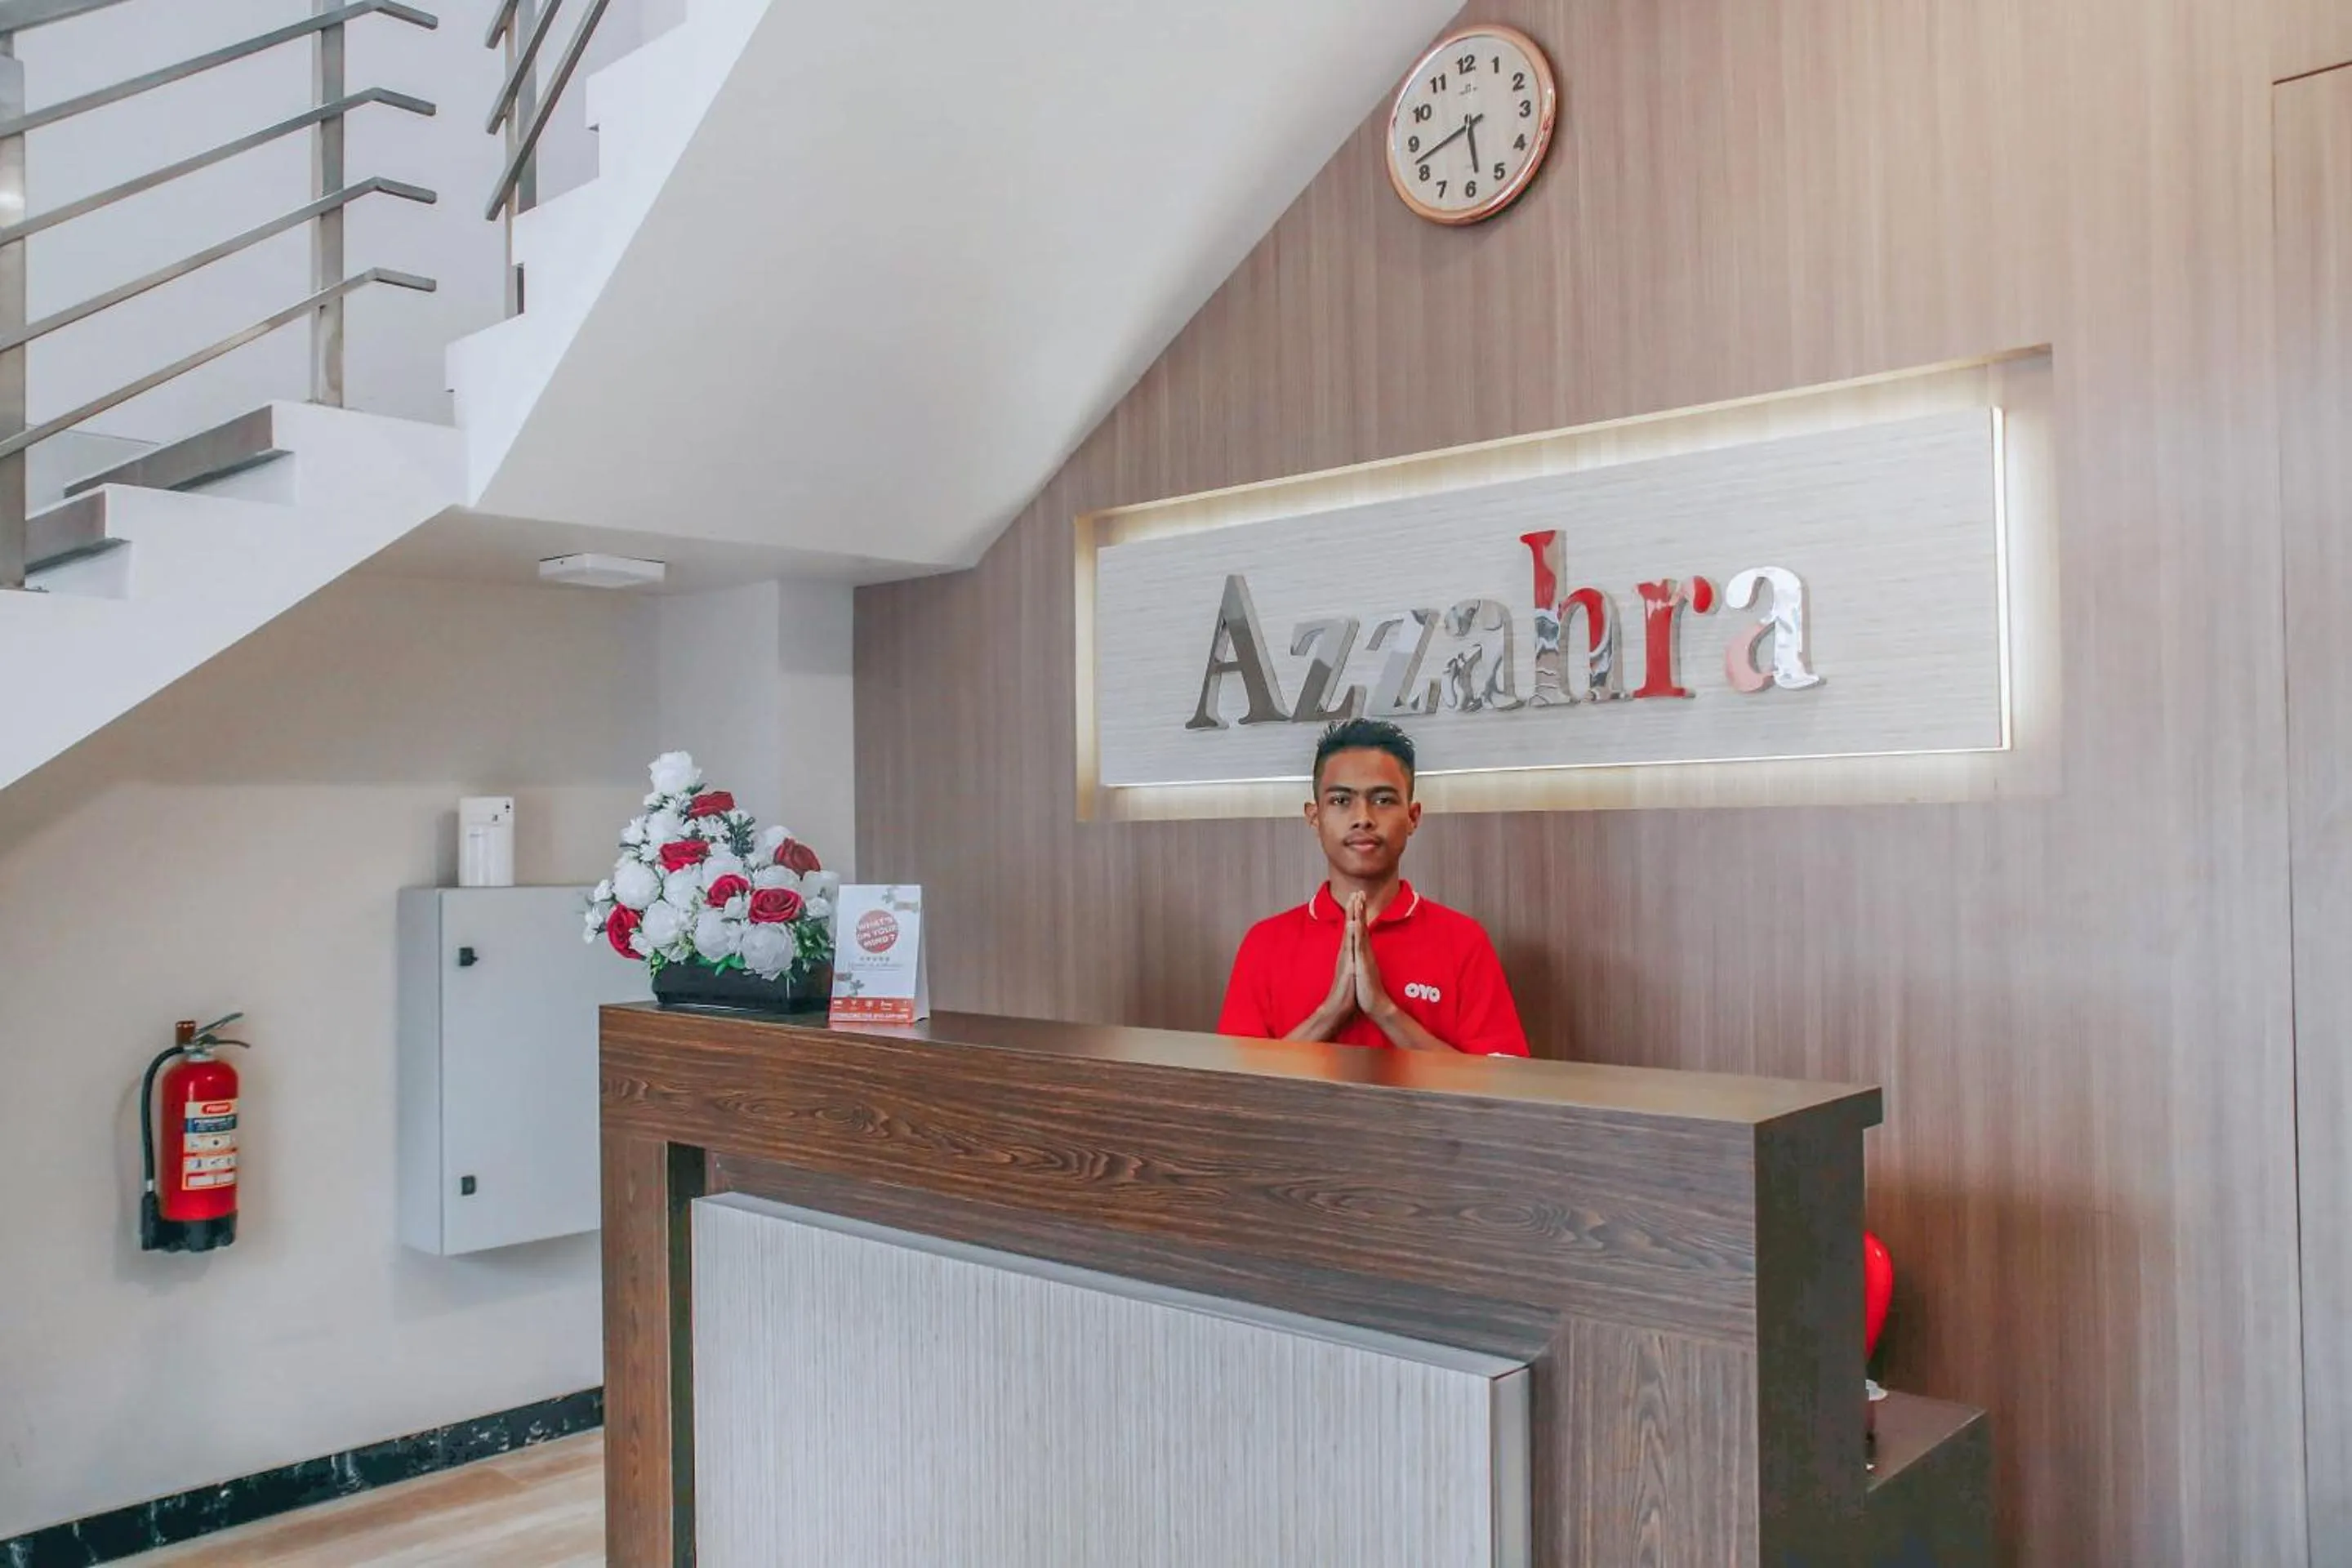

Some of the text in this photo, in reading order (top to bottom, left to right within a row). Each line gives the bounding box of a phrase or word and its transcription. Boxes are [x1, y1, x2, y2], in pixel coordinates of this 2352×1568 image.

[1456, 55, 1476, 75] 12
[1490, 56, 1499, 74] 1
[1430, 74, 1446, 93] 11
[1512, 73, 1525, 91] 2
[1413, 104, 1432, 122] 10
[1519, 100, 1531, 118] 3
[1408, 136, 1420, 153] 9
[1513, 134, 1526, 151] 4
[1419, 164, 1431, 181] 8
[1494, 163, 1505, 180] 5
[1437, 180, 1448, 198] 7
[1465, 180, 1477, 198] 6
[1184, 529, 1828, 730] Azzahra
[1405, 982, 1441, 1003] OYO
